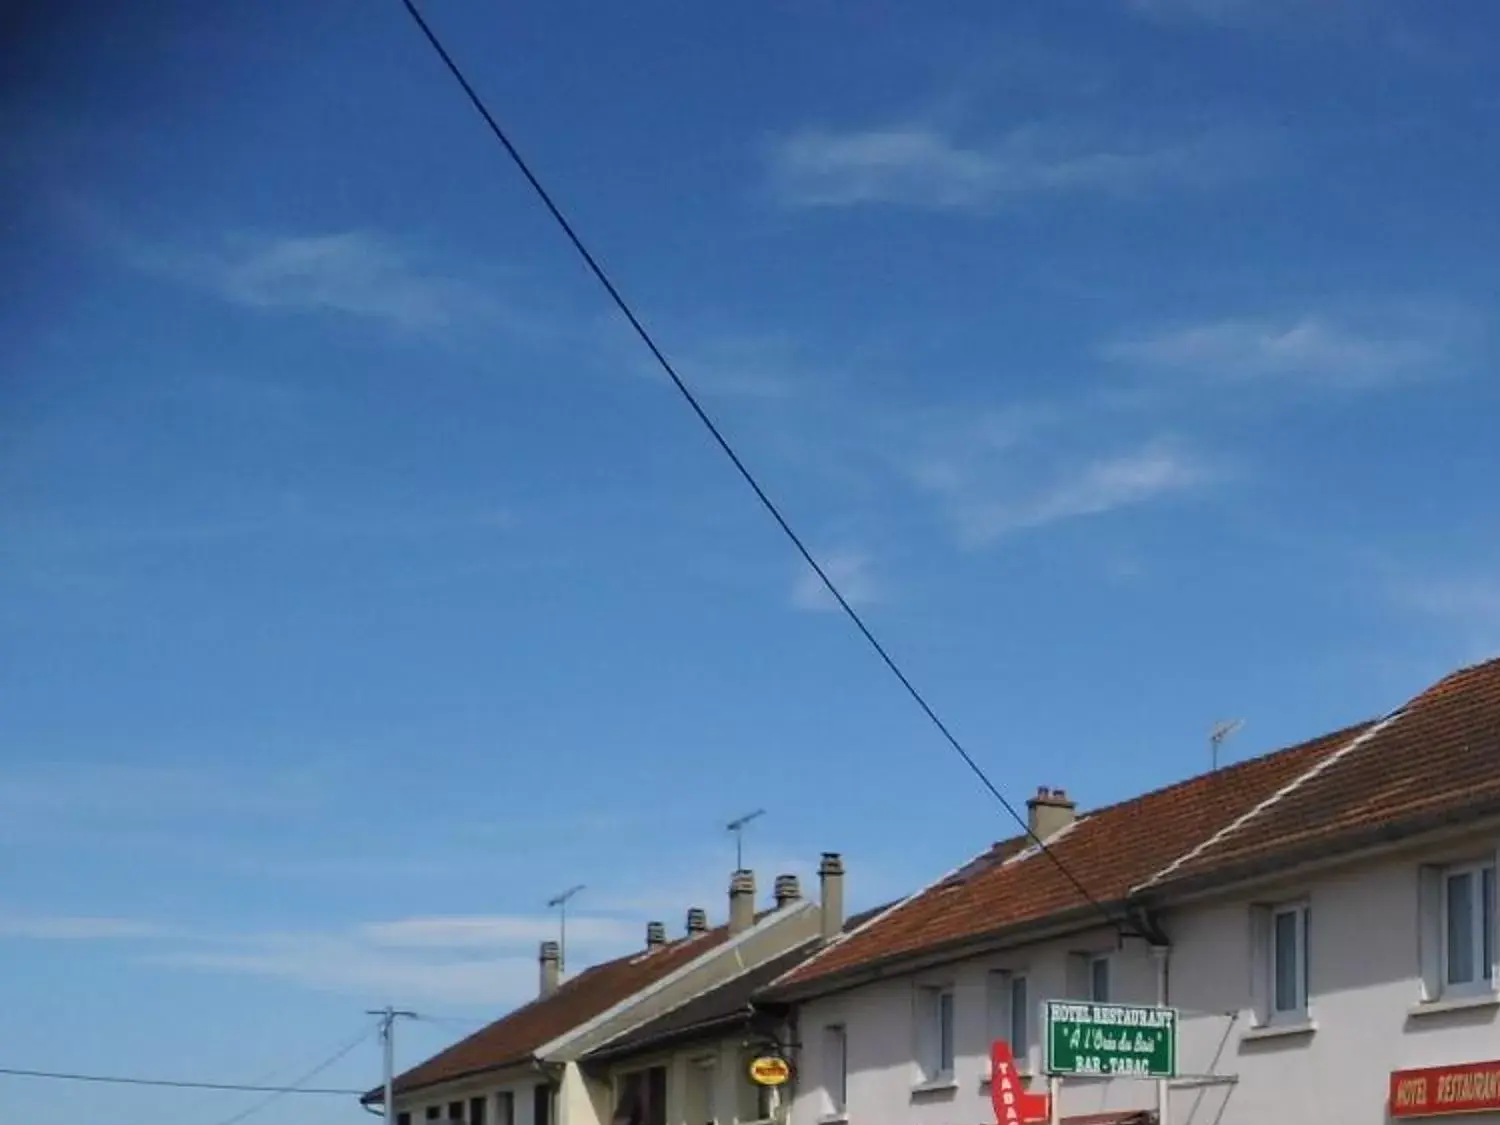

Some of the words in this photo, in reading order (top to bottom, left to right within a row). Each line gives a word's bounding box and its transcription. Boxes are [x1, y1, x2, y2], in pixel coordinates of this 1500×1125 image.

[1050, 1003, 1091, 1023] HOTEL
[1093, 1007, 1173, 1029] RESTAURANT
[1075, 1055, 1101, 1073] BAR
[1109, 1057, 1149, 1077] TABAC
[1396, 1077, 1427, 1106] HOTEL
